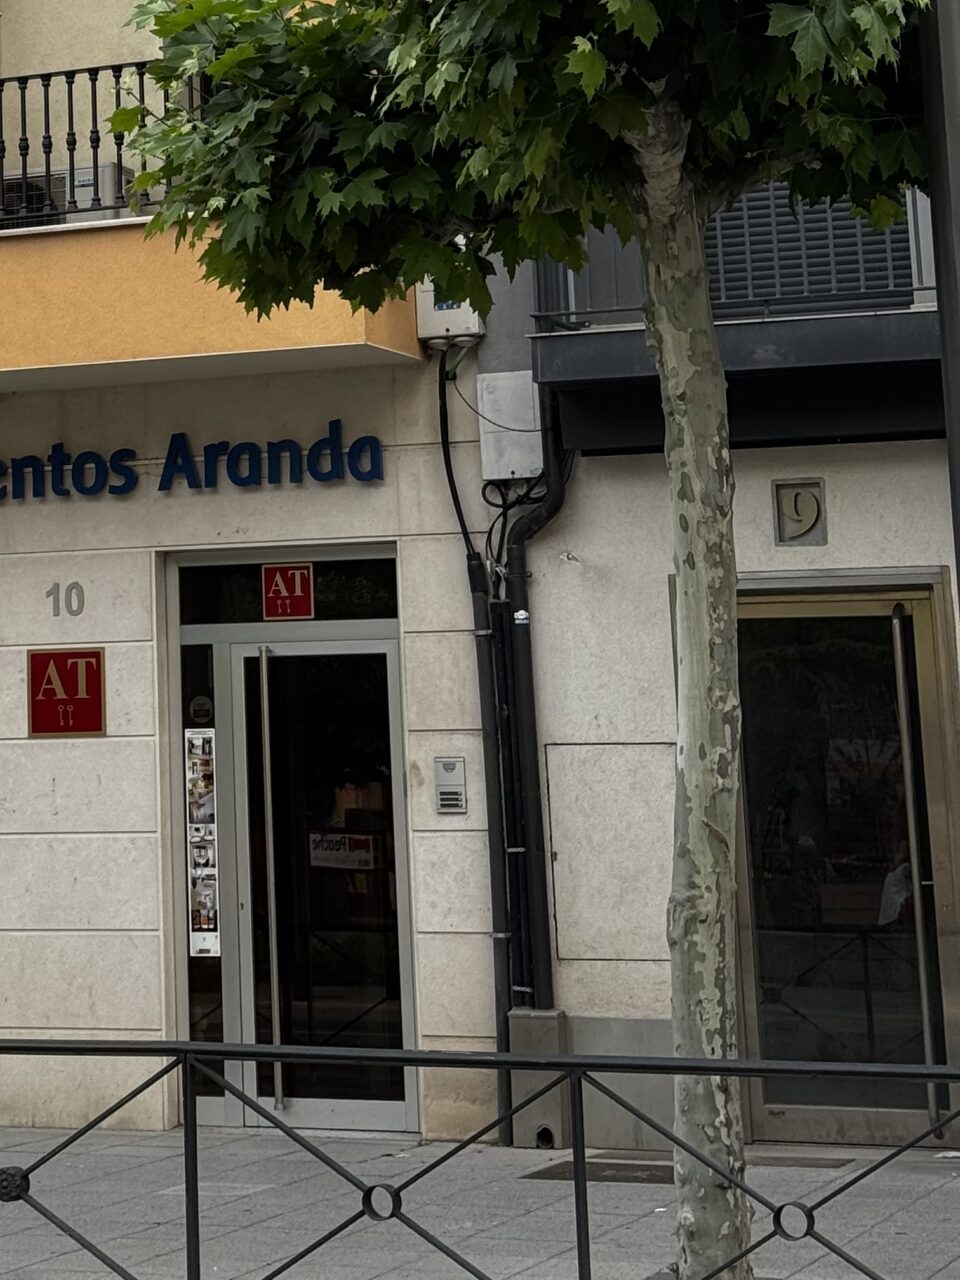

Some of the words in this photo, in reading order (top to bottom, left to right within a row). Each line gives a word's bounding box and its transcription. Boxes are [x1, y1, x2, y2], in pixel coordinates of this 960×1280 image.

[157, 419, 385, 492] Aranda
[781, 489, 820, 540] 9
[45, 581, 85, 617] 10
[267, 569, 309, 597] AT
[35, 657, 97, 701] AT
